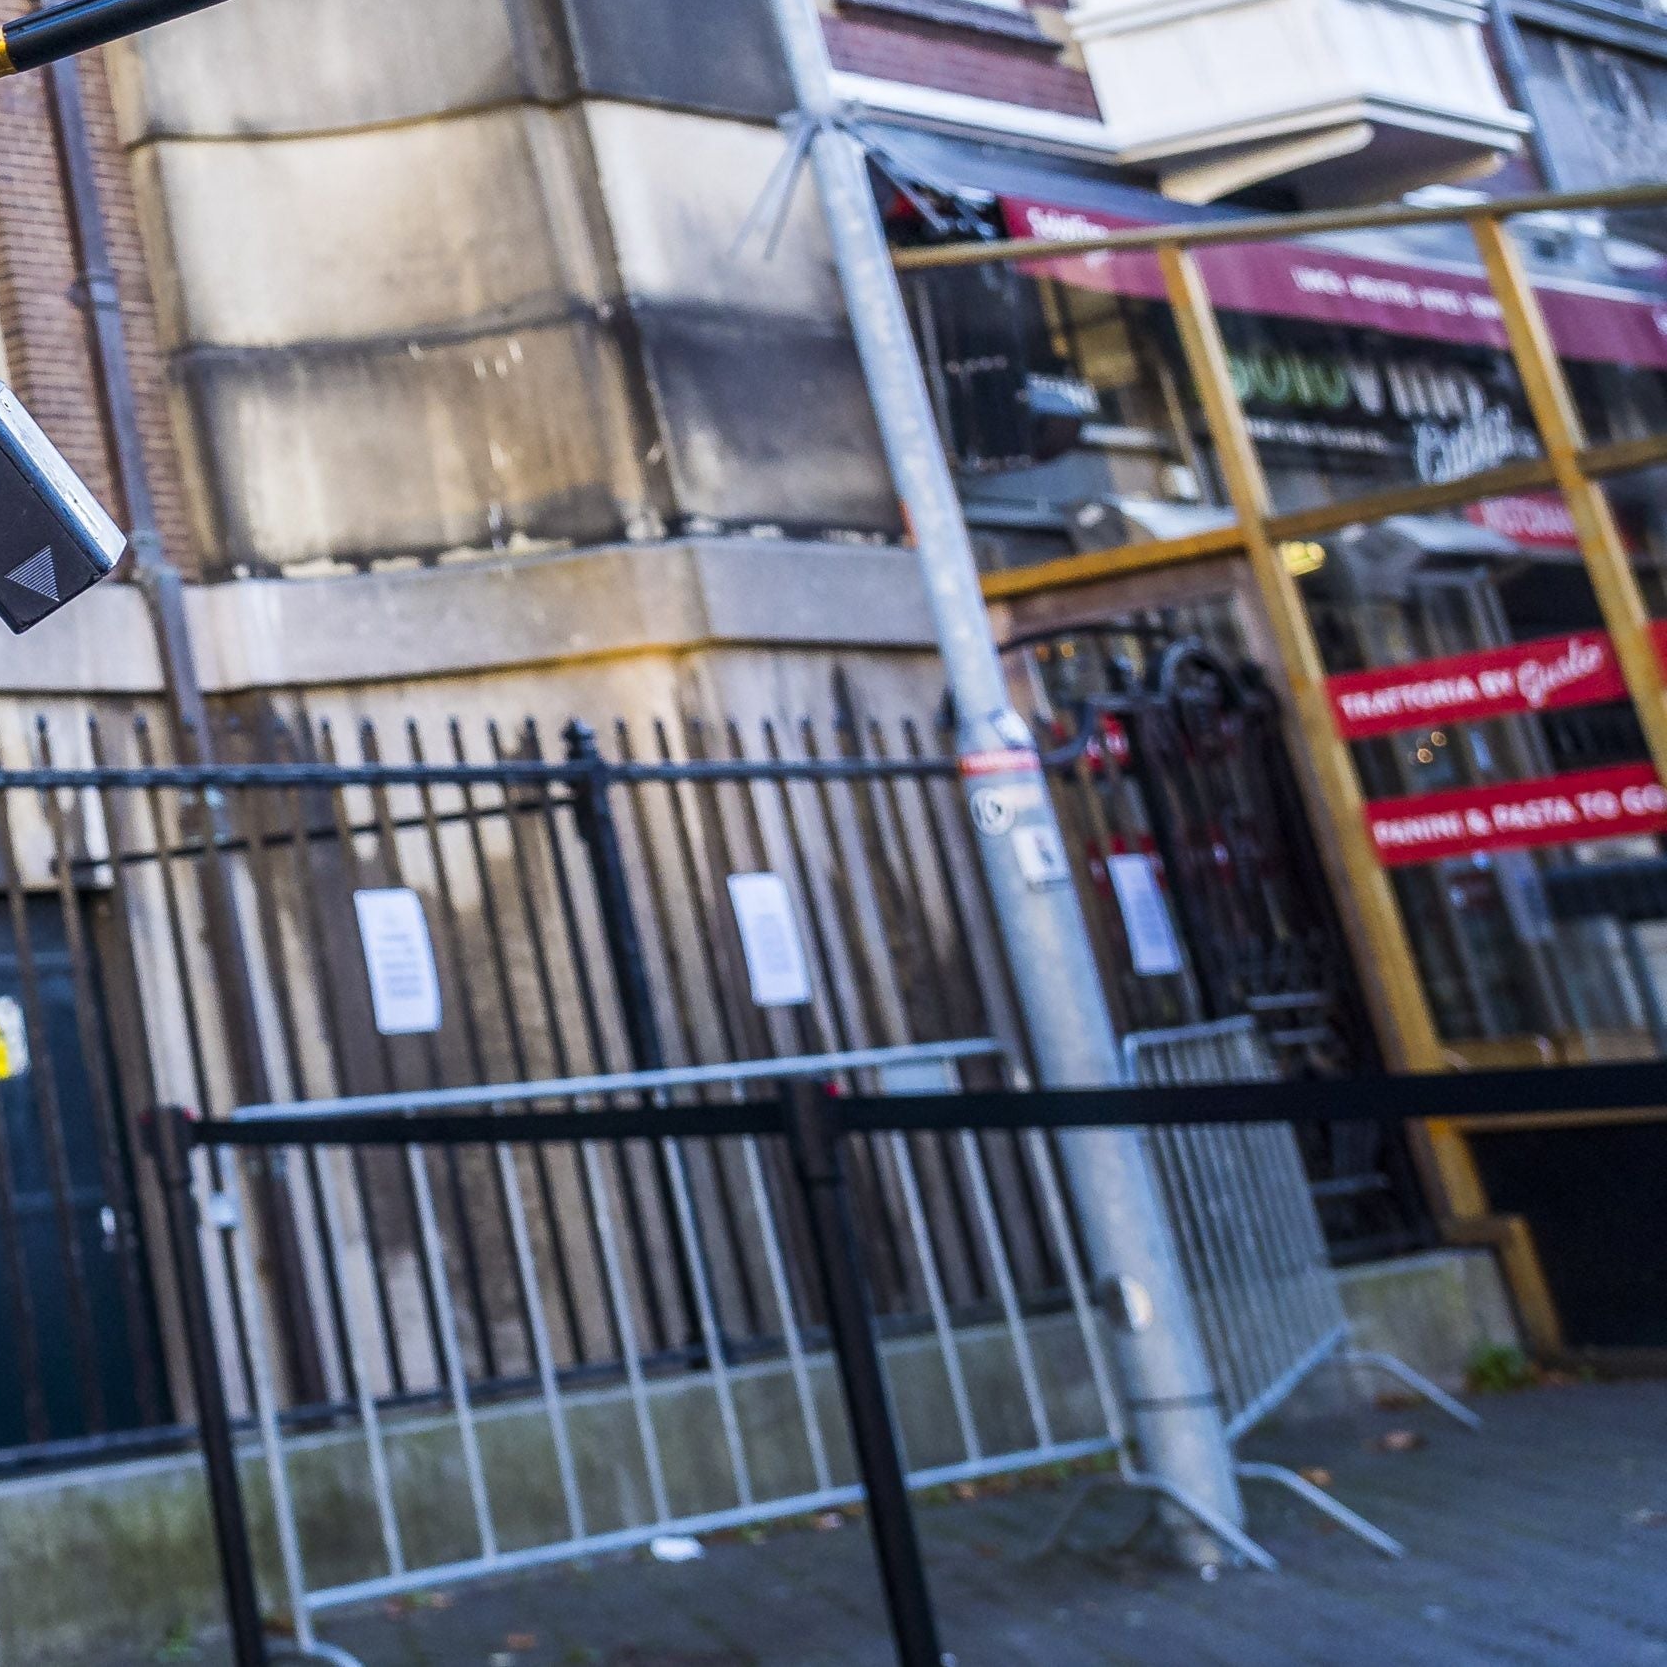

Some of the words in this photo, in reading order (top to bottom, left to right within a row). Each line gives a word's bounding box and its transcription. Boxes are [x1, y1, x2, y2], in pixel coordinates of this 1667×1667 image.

[1339, 675, 1478, 720] TRATTORIA
[1478, 670, 1514, 699] BY
[1371, 811, 1464, 847] PANINI
[1491, 795, 1580, 831] PASTA
[1573, 790, 1621, 821] TO
